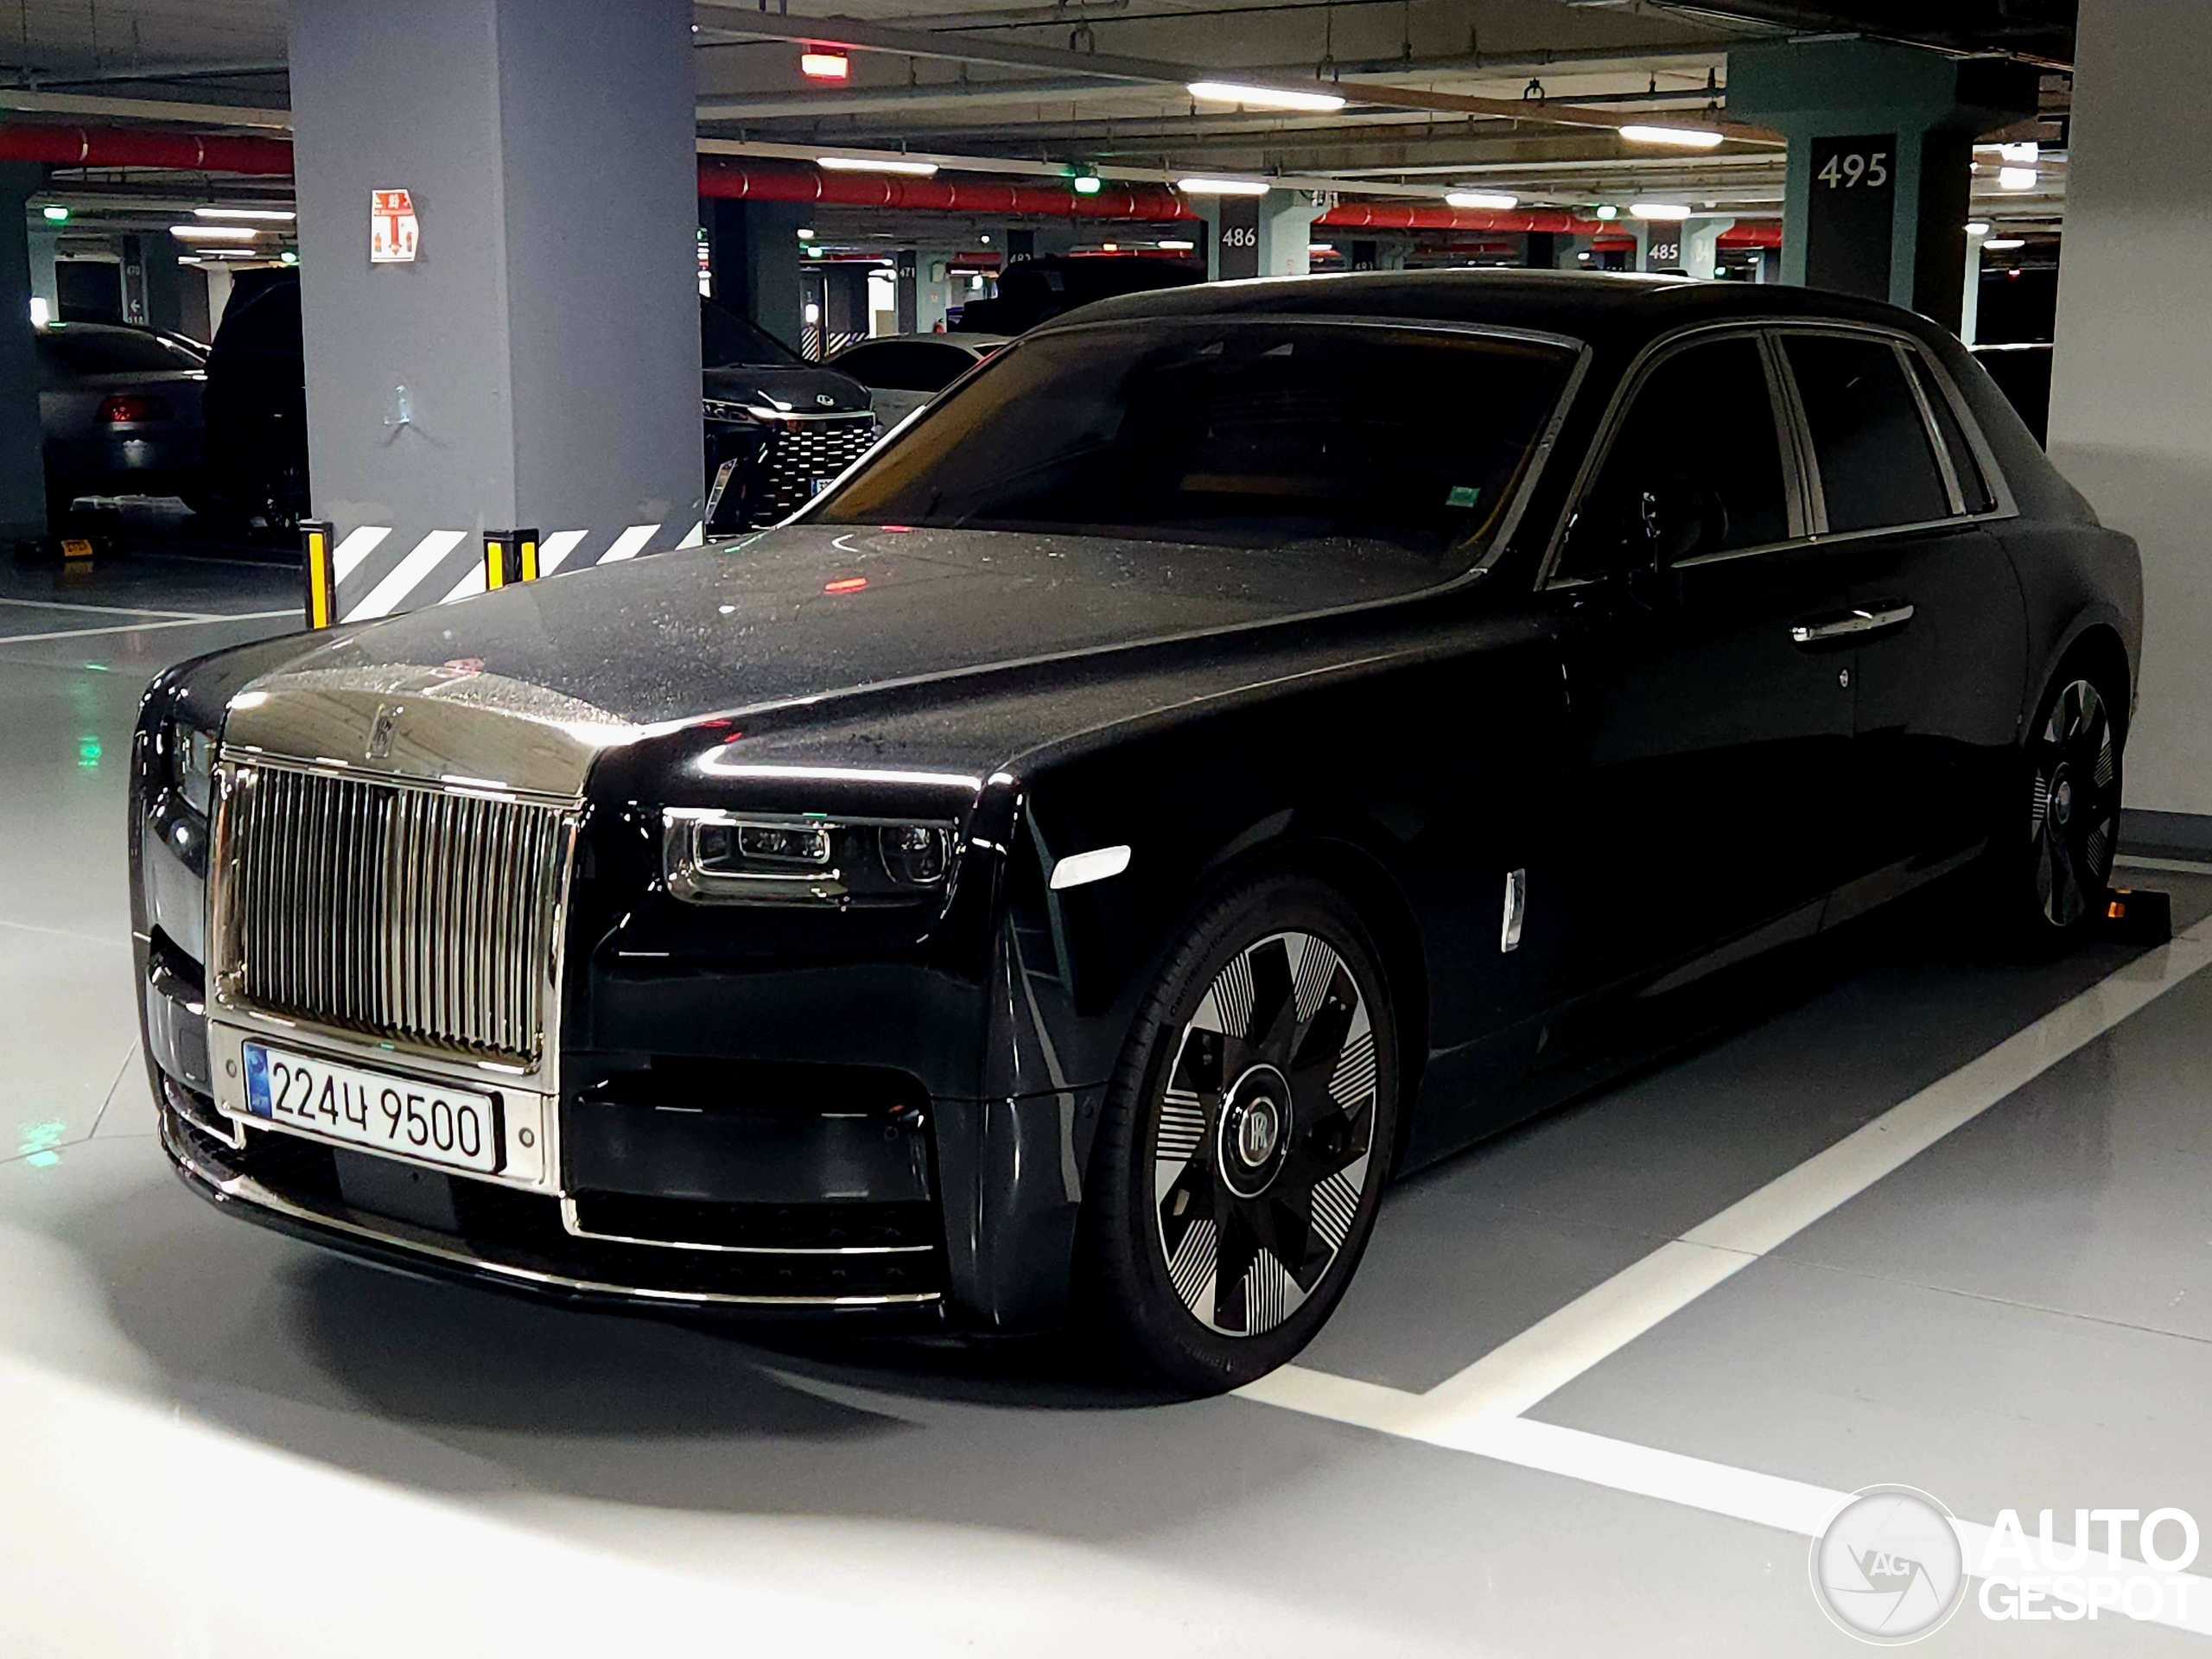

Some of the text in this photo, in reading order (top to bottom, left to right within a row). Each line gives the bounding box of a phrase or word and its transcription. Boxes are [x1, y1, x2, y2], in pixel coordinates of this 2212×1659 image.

[1817, 153, 1887, 188] 495
[1222, 226, 1255, 247] 486
[1649, 244, 1678, 259] 485
[380, 1088, 480, 1157] 9500
